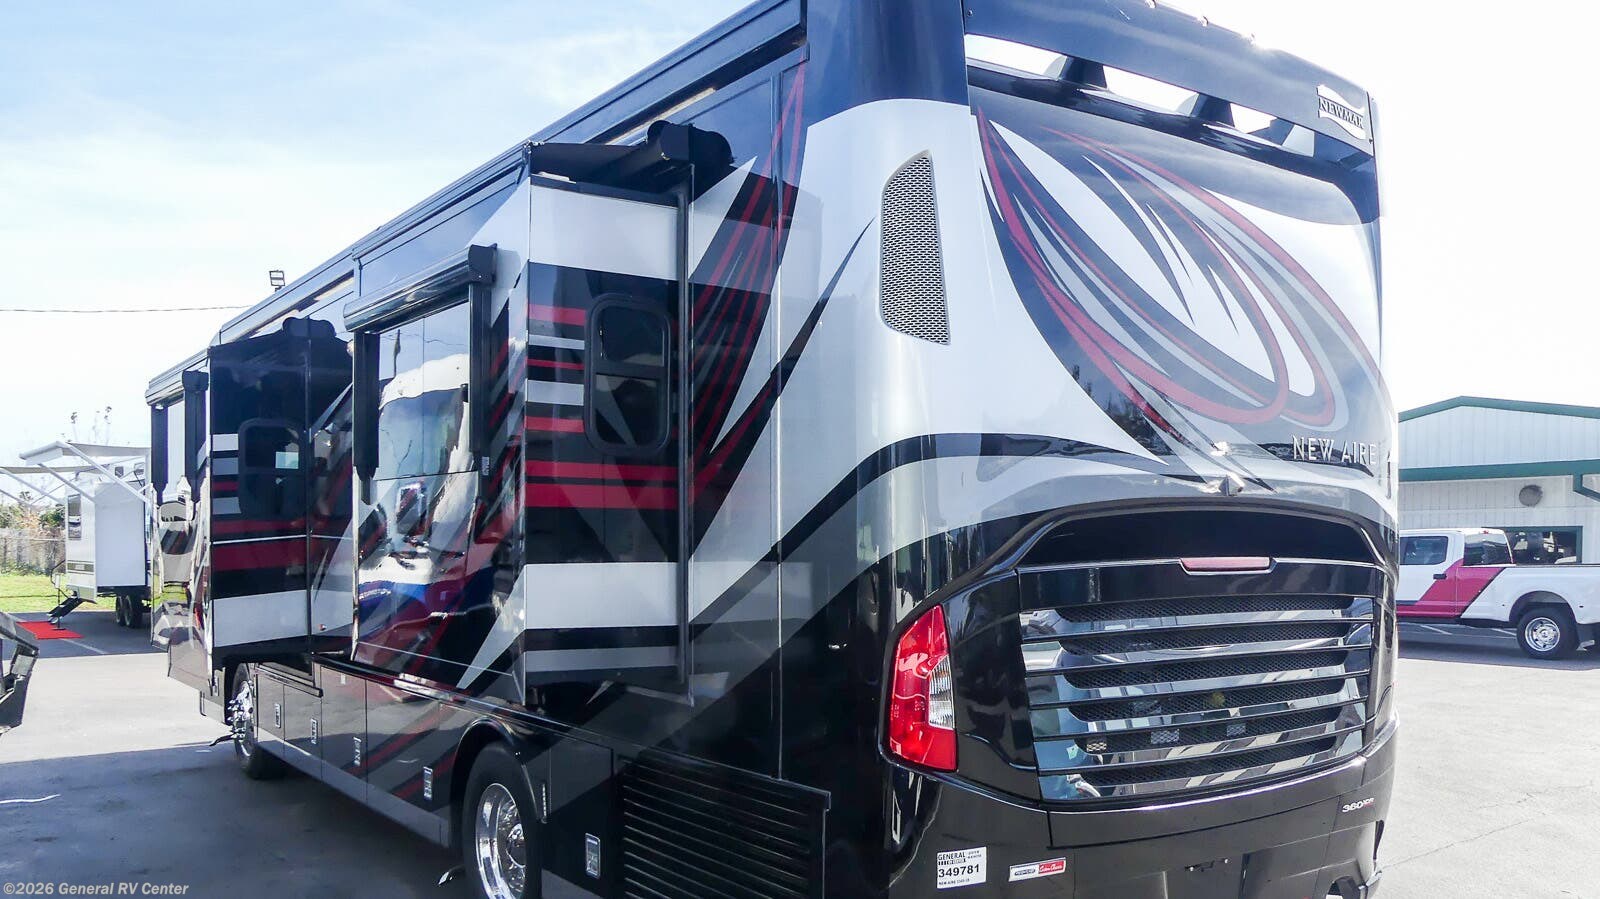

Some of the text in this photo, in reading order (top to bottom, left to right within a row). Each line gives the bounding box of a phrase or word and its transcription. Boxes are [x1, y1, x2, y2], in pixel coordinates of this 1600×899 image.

[1292, 434, 1377, 465] NEW AIRE
[938, 851, 966, 861] GENERAL
[938, 863, 980, 878] 349781
